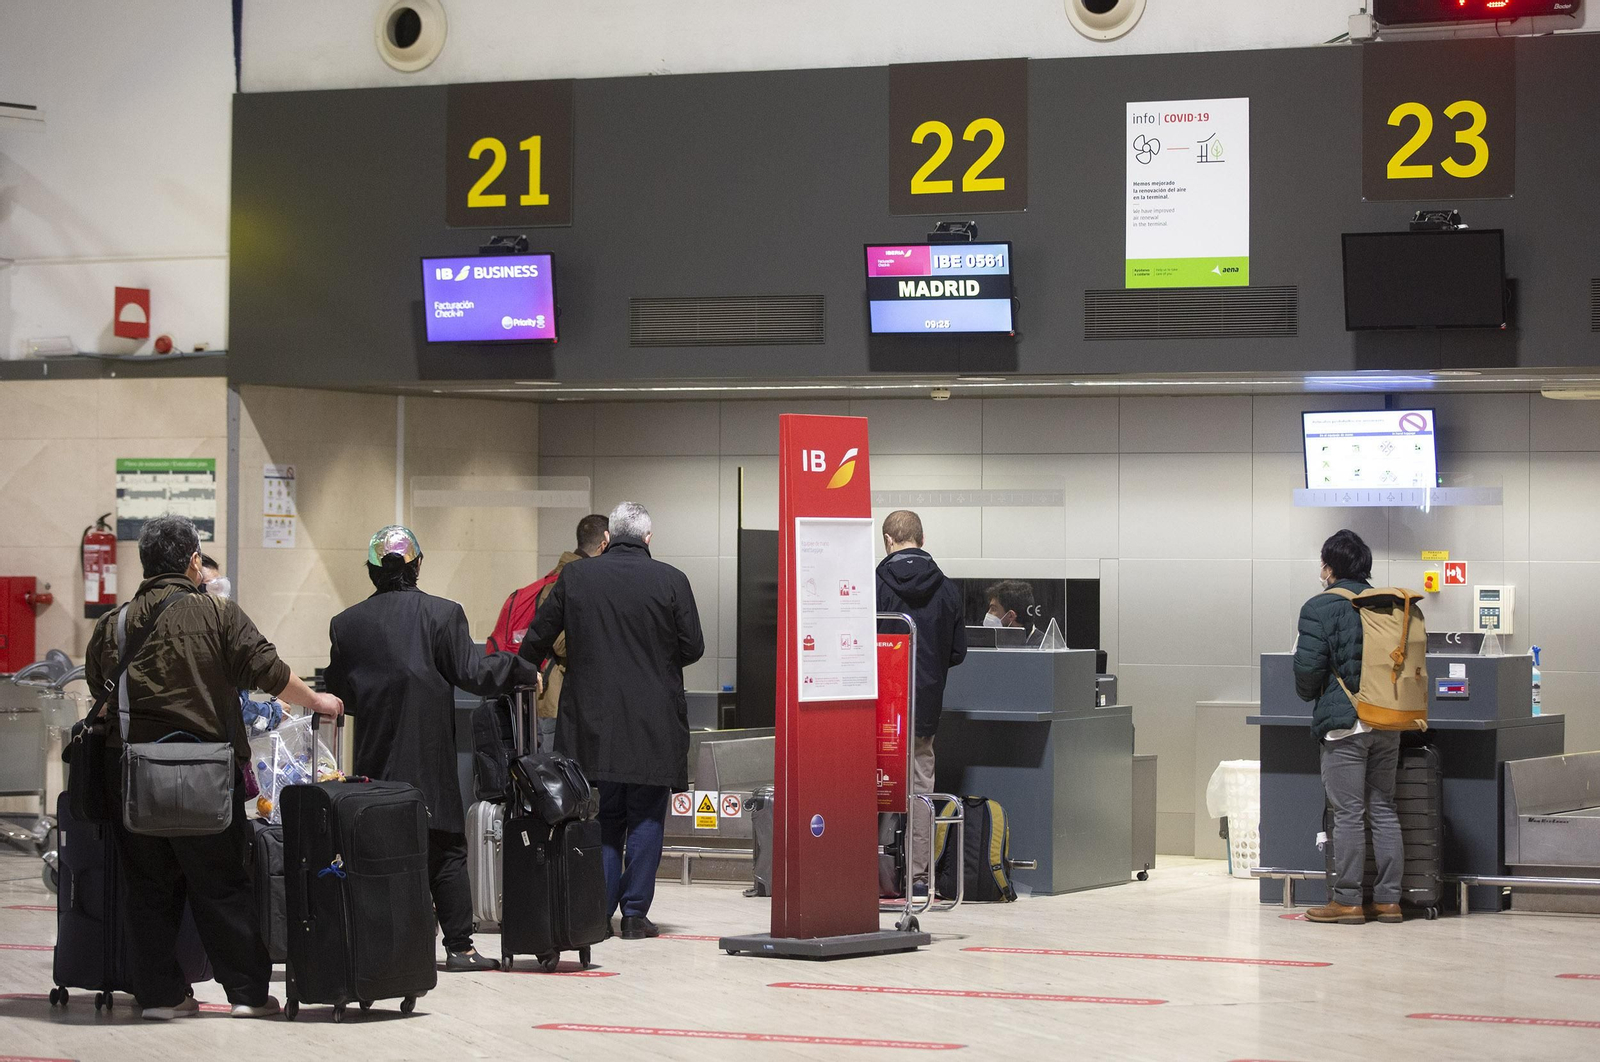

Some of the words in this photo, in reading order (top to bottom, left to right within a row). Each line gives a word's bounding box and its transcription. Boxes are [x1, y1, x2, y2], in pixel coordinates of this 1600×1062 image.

[1132, 112, 1155, 124] info
[1164, 112, 1210, 123] COVID-19
[1387, 100, 1489, 179] 23
[910, 118, 1006, 194] 22
[467, 135, 550, 207] 21
[933, 255, 963, 269] IBE
[435, 268, 453, 281] IB
[473, 265, 539, 279] BUSINESS
[898, 279, 980, 297] MADRID
[434, 300, 475, 311] Facturación
[434, 309, 464, 318] Check-in
[513, 317, 536, 328] Priority
[802, 449, 826, 472] IB
[1026, 604, 1042, 617] CE
[1445, 632, 1461, 643] CE
